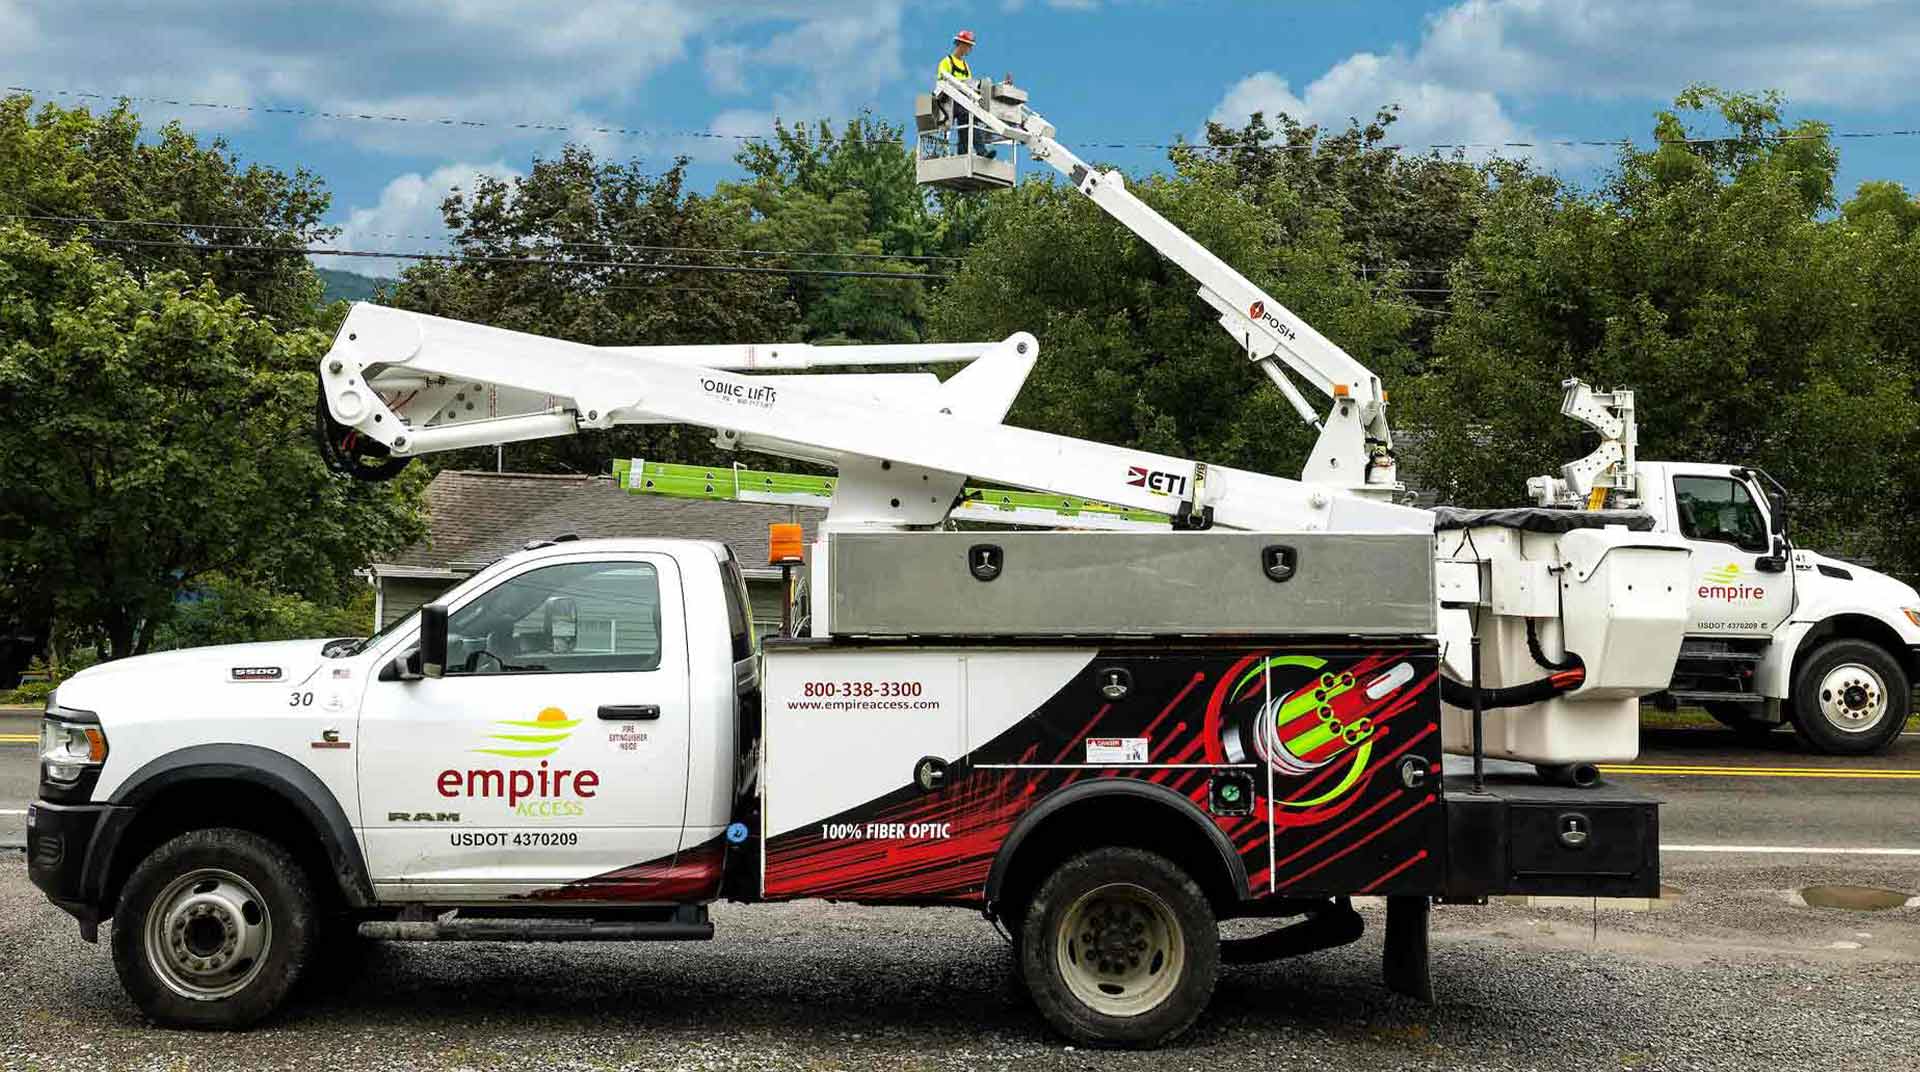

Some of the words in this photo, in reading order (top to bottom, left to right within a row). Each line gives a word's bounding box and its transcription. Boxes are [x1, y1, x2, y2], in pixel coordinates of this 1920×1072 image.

[701, 378, 744, 397] OBILE
[748, 385, 777, 402] LIFTS
[1148, 470, 1186, 495] ETI
[1698, 583, 1764, 602] empire
[1697, 622, 1725, 630] USDOT
[804, 682, 922, 697] 800-338-3300
[289, 692, 314, 706] 30
[787, 699, 940, 712] www.empireaccess.com
[437, 760, 599, 807] empire
[515, 800, 584, 817] ACCESS
[388, 812, 460, 822] RAM
[450, 833, 508, 846] USDOT
[513, 833, 578, 846] 4370209
[822, 824, 862, 840] 100%
[866, 823, 905, 839] FIBER
[909, 823, 950, 838] OPTIC
